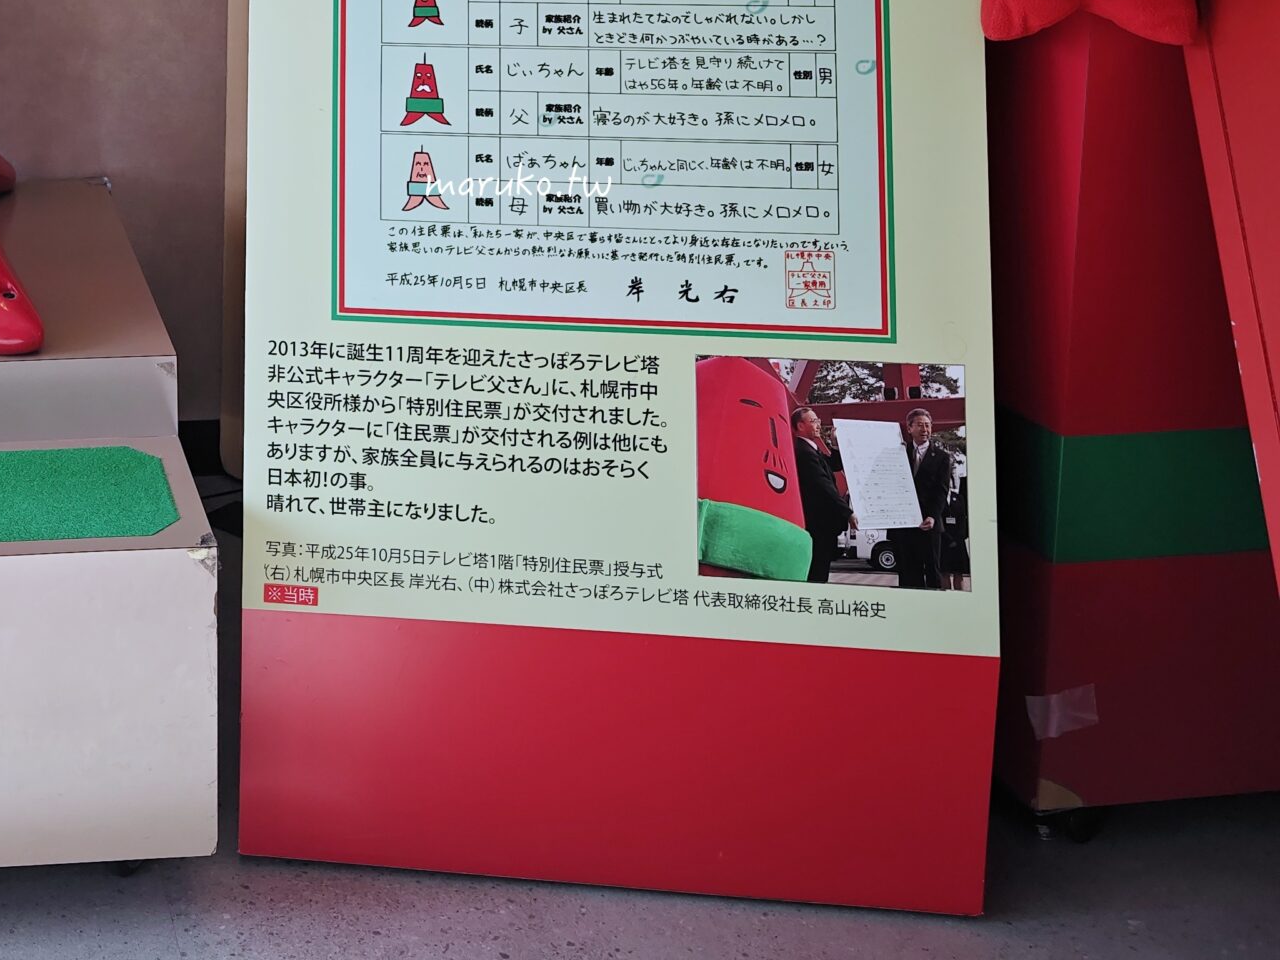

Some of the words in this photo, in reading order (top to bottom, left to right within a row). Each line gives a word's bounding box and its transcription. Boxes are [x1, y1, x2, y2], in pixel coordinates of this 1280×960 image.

[510, 18, 528, 35] 子
[475, 65, 493, 74] 氏名
[625, 56, 785, 70] テレビ塔を見守り続けて
[793, 70, 813, 80] 性別
[819, 68, 832, 85] 男
[509, 108, 529, 125] 父
[475, 154, 493, 163] 氏名
[795, 162, 814, 172] 性別
[818, 160, 834, 176] 女
[509, 197, 528, 215] 母
[386, 272, 486, 290] 平成25年10月5日
[498, 276, 588, 294] 札幌市中央区長
[267, 340, 660, 375] 2013年に誕生11周年を迎えたさっぽろテレビ塔
[267, 365, 658, 400] 非公式キャラクター「テレビ父さん」に、札幌市中
[267, 391, 668, 428] 央区役所様から「特別住民票」が交付されました。
[267, 416, 668, 454] キャラクターに「住民票」が交付される例は他にも
[267, 442, 651, 480] ありますが、家族全員に与えられるのはおそらく
[266, 494, 497, 525] 晴れて、世帯主になりました。
[693, 590, 813, 615] 代表取締役社長
[818, 598, 887, 619] 高山裕史
